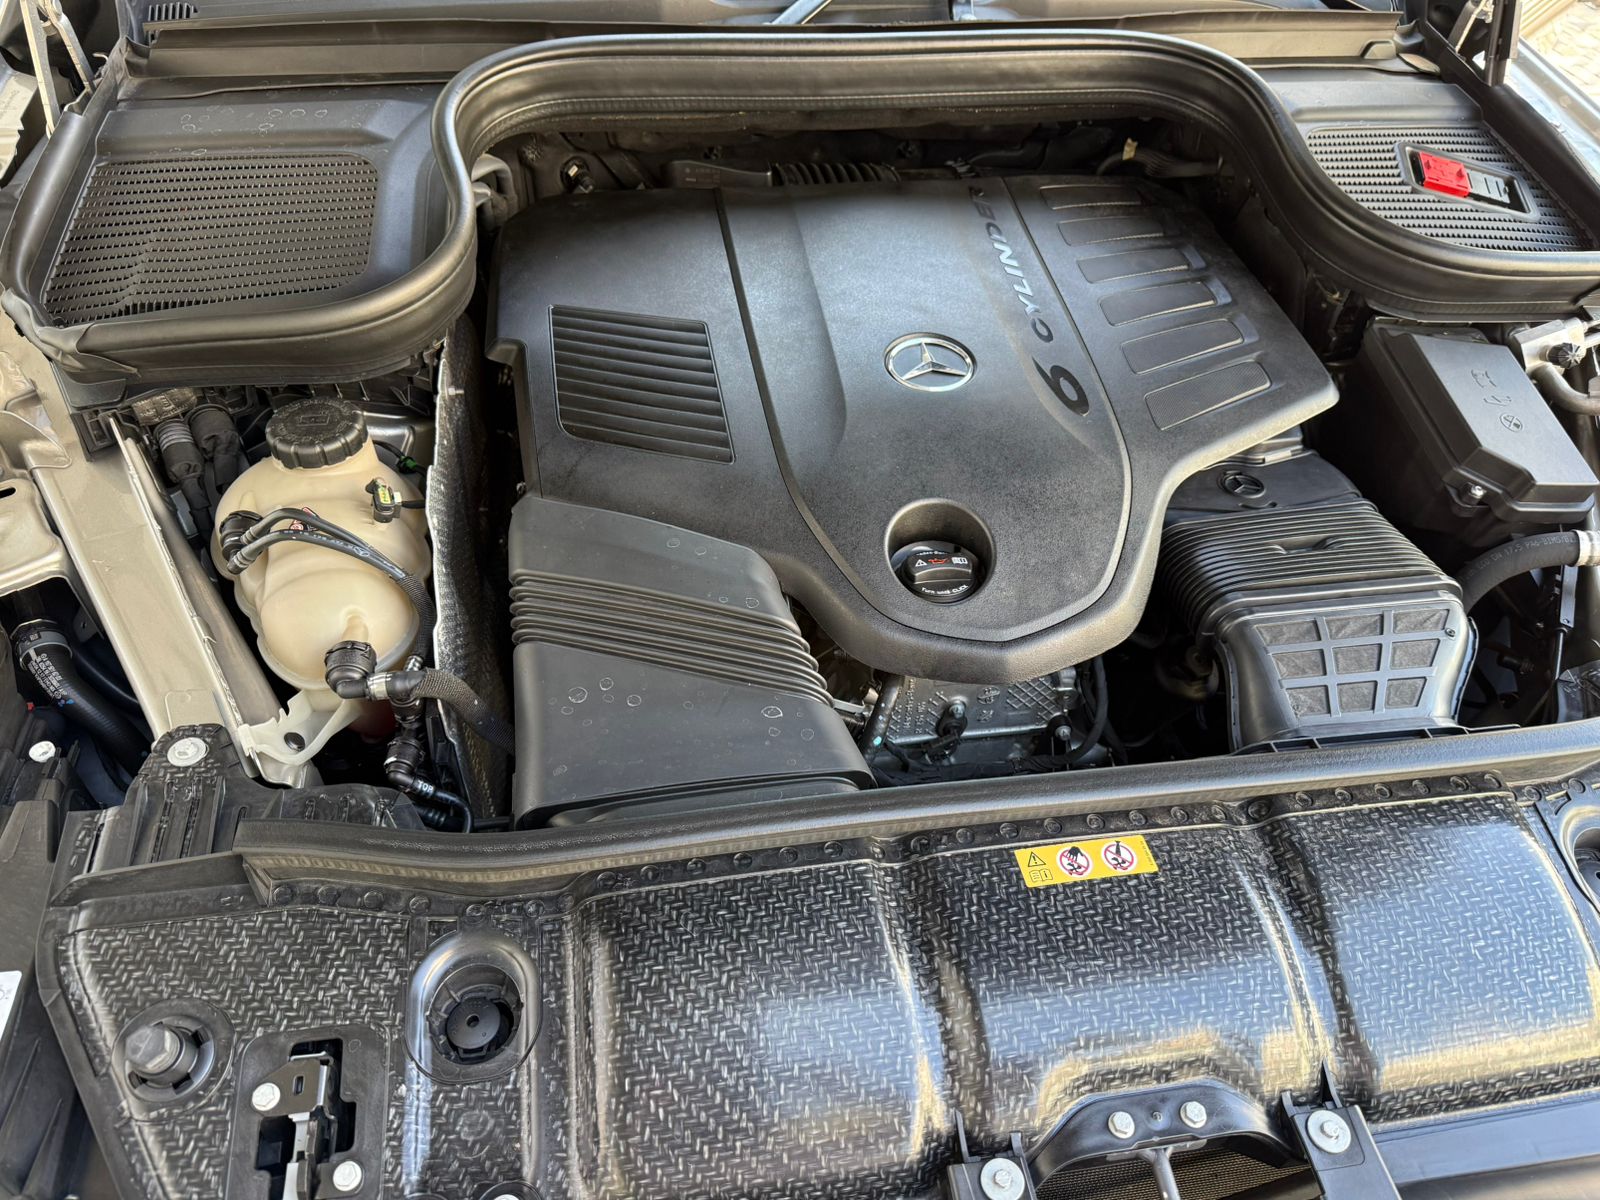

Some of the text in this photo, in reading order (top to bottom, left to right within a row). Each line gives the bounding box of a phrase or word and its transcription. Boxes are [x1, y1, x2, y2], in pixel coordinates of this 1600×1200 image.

[969, 186, 1090, 417] 6 CYLINDER
[417, 779, 434, 793] TOP
